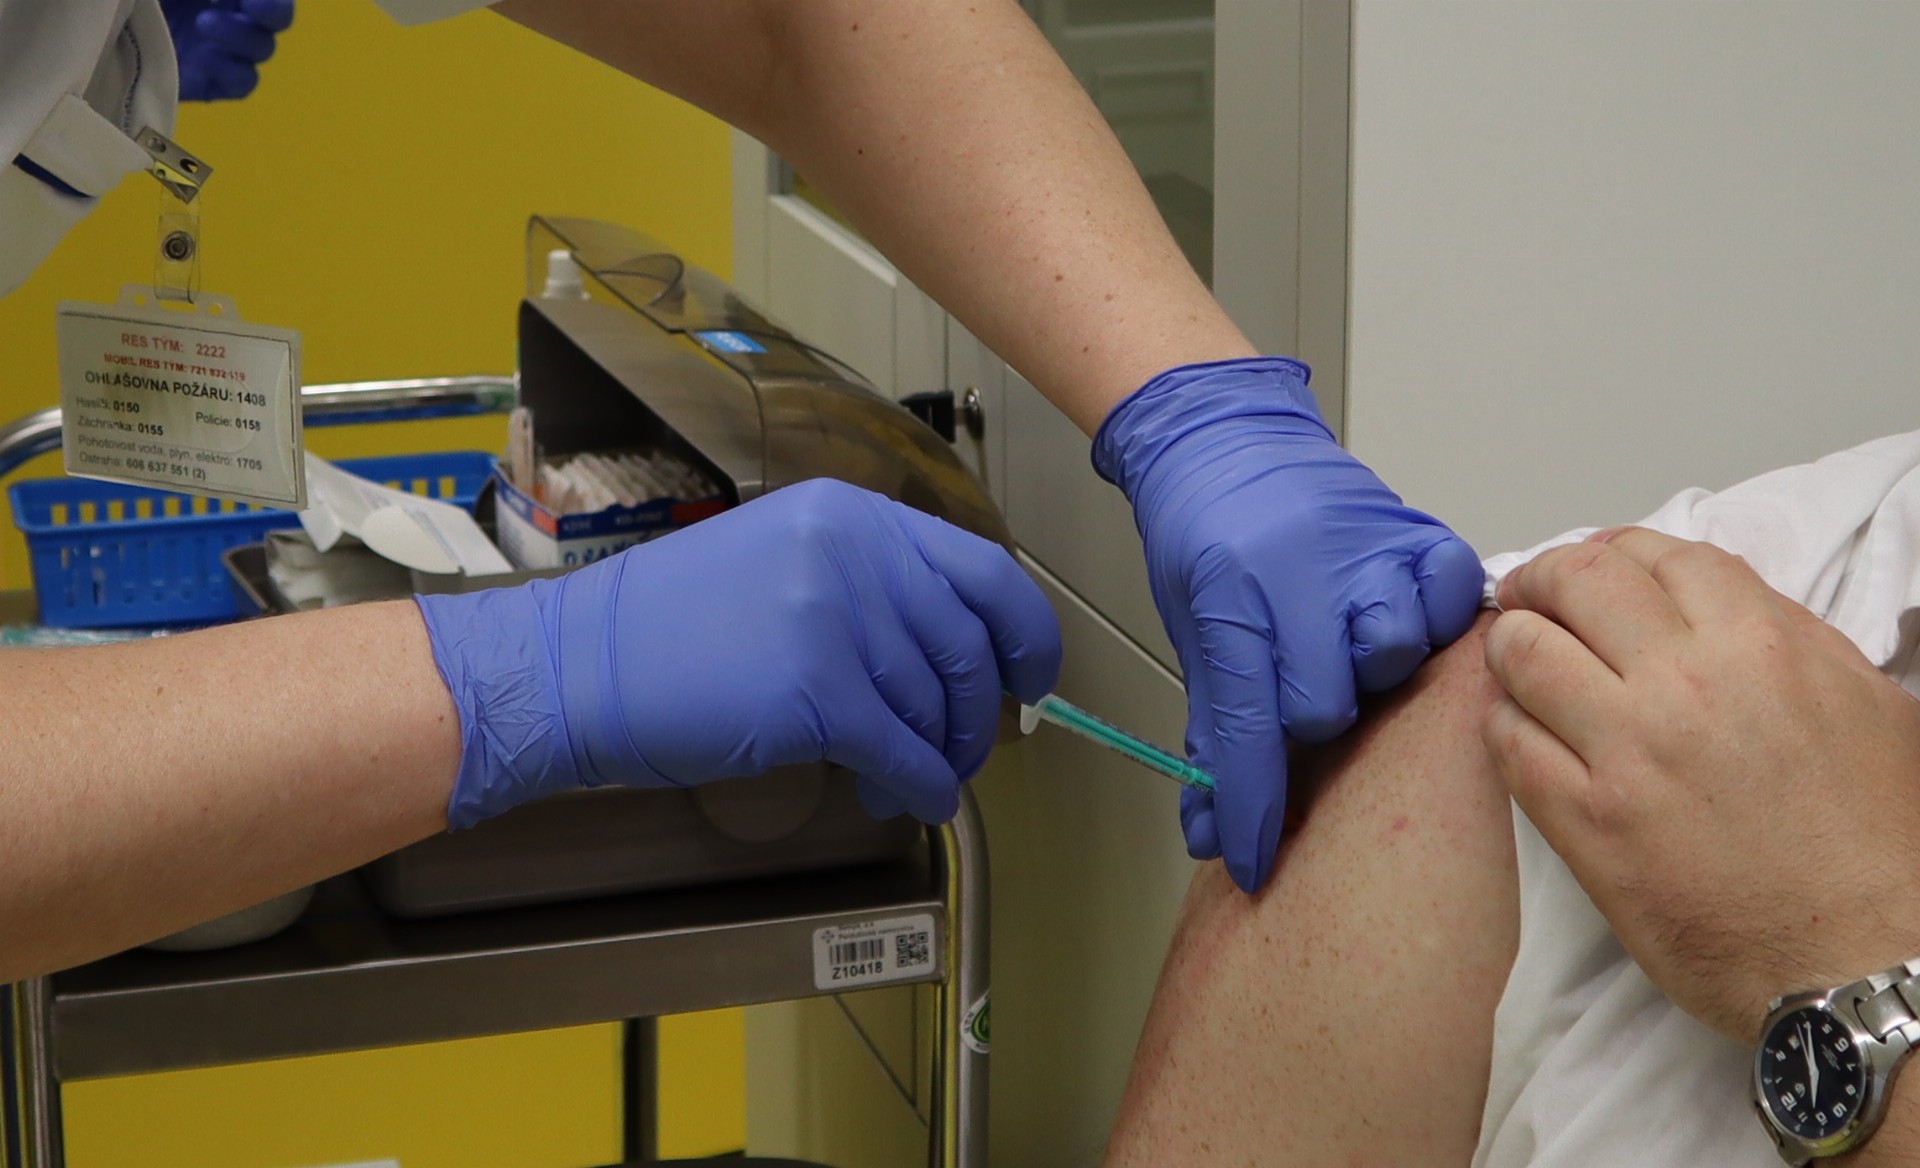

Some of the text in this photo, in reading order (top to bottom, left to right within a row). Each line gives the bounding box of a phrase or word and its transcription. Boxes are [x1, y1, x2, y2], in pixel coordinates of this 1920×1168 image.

[121, 333, 226, 358] RES TÝM: 2222
[103, 353, 137, 367] MOBIL
[139, 357, 160, 369] RES
[163, 360, 187, 373] TÝM:
[190, 364, 206, 375] 721
[85, 370, 266, 407] OHLAŠOVNA POŽÁRU: 1408
[113, 401, 140, 414] 0150
[137, 423, 164, 436] 0155
[195, 412, 261, 432] Policie: 0158
[78, 434, 136, 452] Pohotovost
[236, 457, 263, 471] 1705
[170, 464, 190, 477] 551
[192, 467, 206, 481] (2)
[832, 961, 883, 980] Z10418
[1822, 1024, 1833, 1035] 5
[1834, 1037, 1850, 1053] 6
[1775, 1050, 1787, 1062] 2
[1846, 1063, 1857, 1072] 7
[1845, 1084, 1857, 1096] 8
[1780, 1091, 1798, 1112] 12
[1798, 1112, 1808, 1123] 11
[1815, 1111, 1828, 1126] 10
[1832, 1102, 1848, 1119] 9
